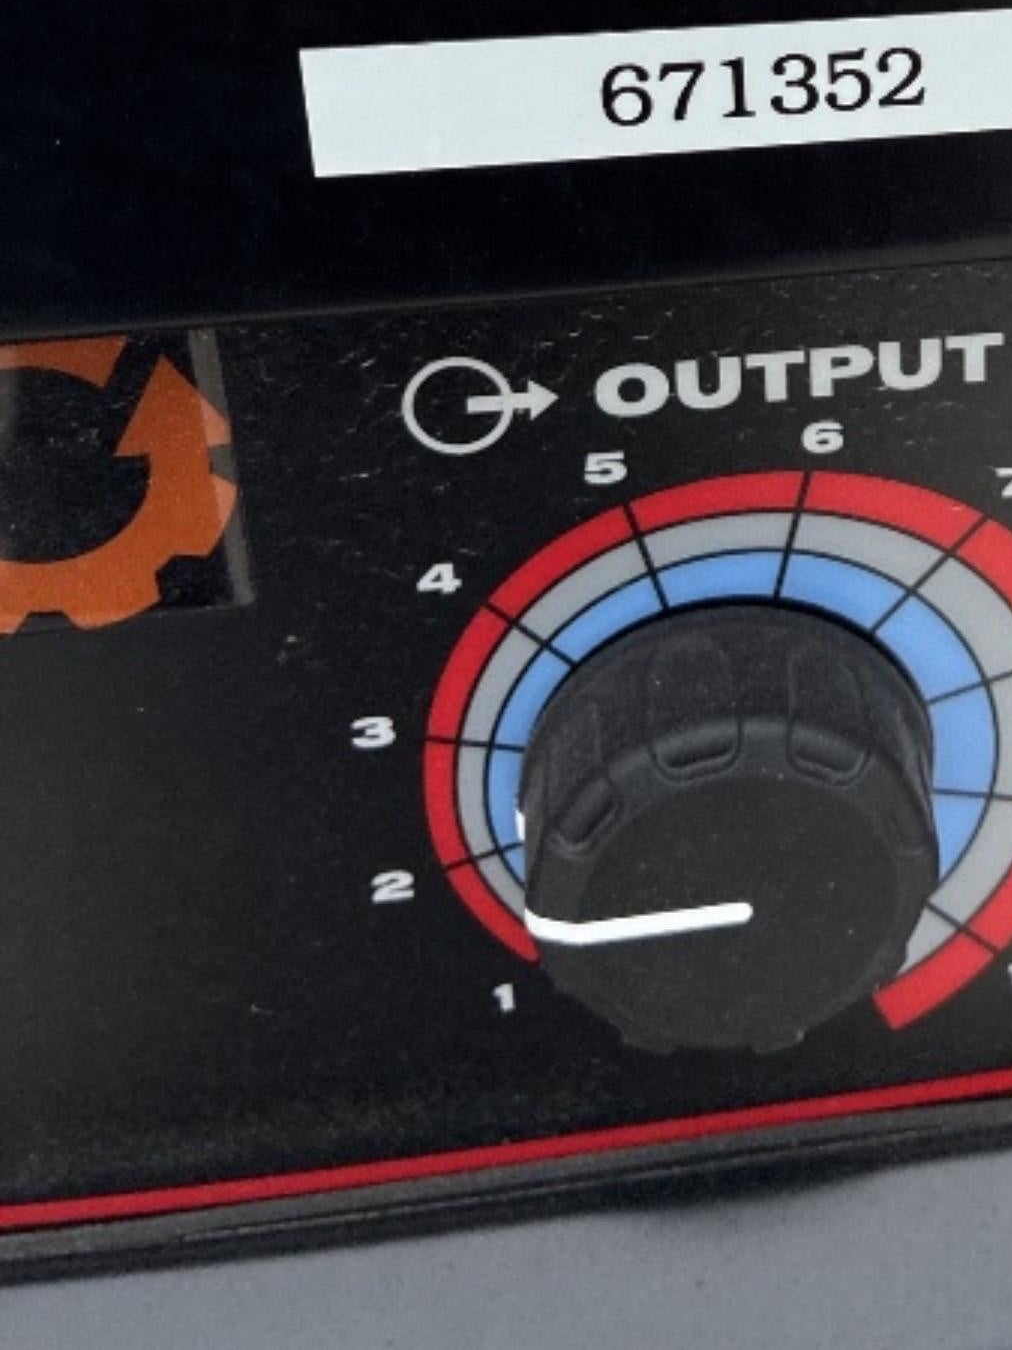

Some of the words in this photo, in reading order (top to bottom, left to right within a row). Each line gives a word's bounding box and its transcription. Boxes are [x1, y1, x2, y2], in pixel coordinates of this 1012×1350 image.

[602, 47, 926, 126] 671352
[594, 333, 1005, 419] OUTPUT
[803, 420, 844, 453] 6
[584, 451, 628, 485] 5
[416, 562, 462, 594] 4
[351, 716, 396, 749] 3
[371, 870, 415, 903] 2
[493, 982, 515, 1012] 1
